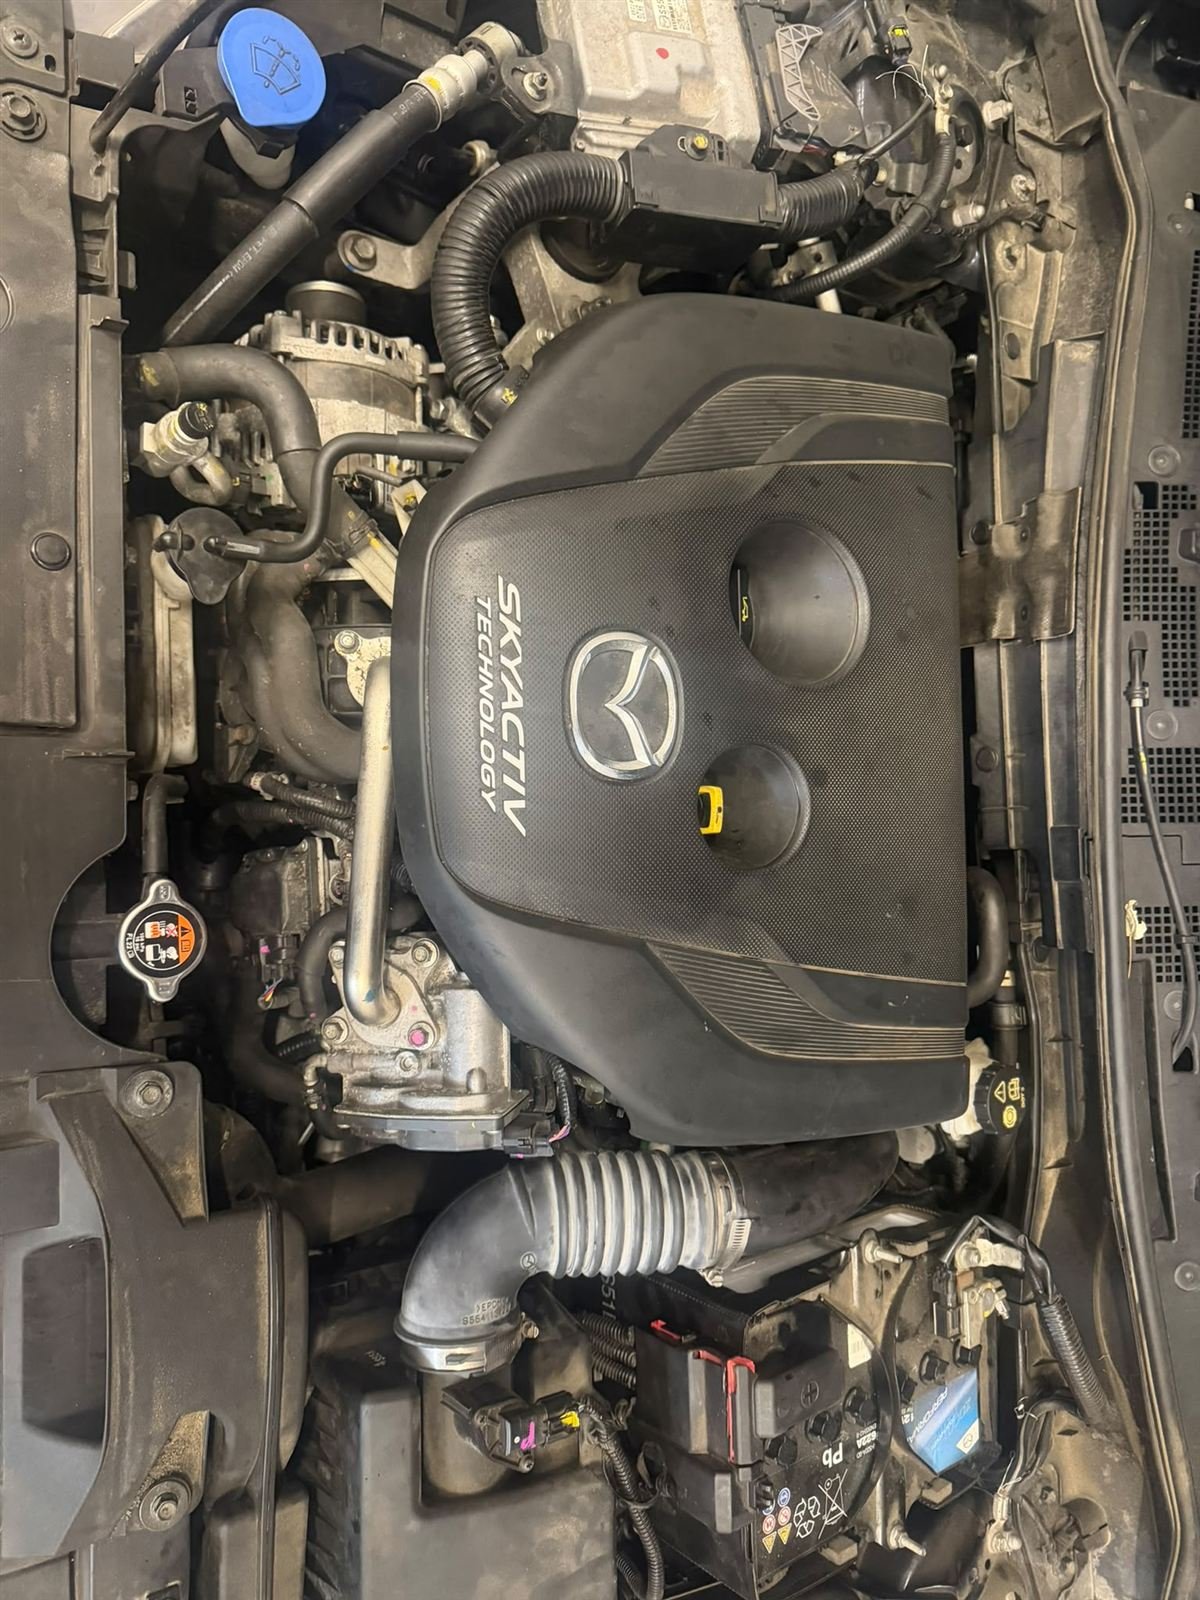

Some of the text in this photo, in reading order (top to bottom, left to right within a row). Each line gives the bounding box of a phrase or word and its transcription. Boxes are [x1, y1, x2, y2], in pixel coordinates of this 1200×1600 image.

[476, 596, 496, 813] TECHNOLOGY
[498, 575, 526, 838] SKYACTIV
[822, 1442, 844, 1468] Pb
